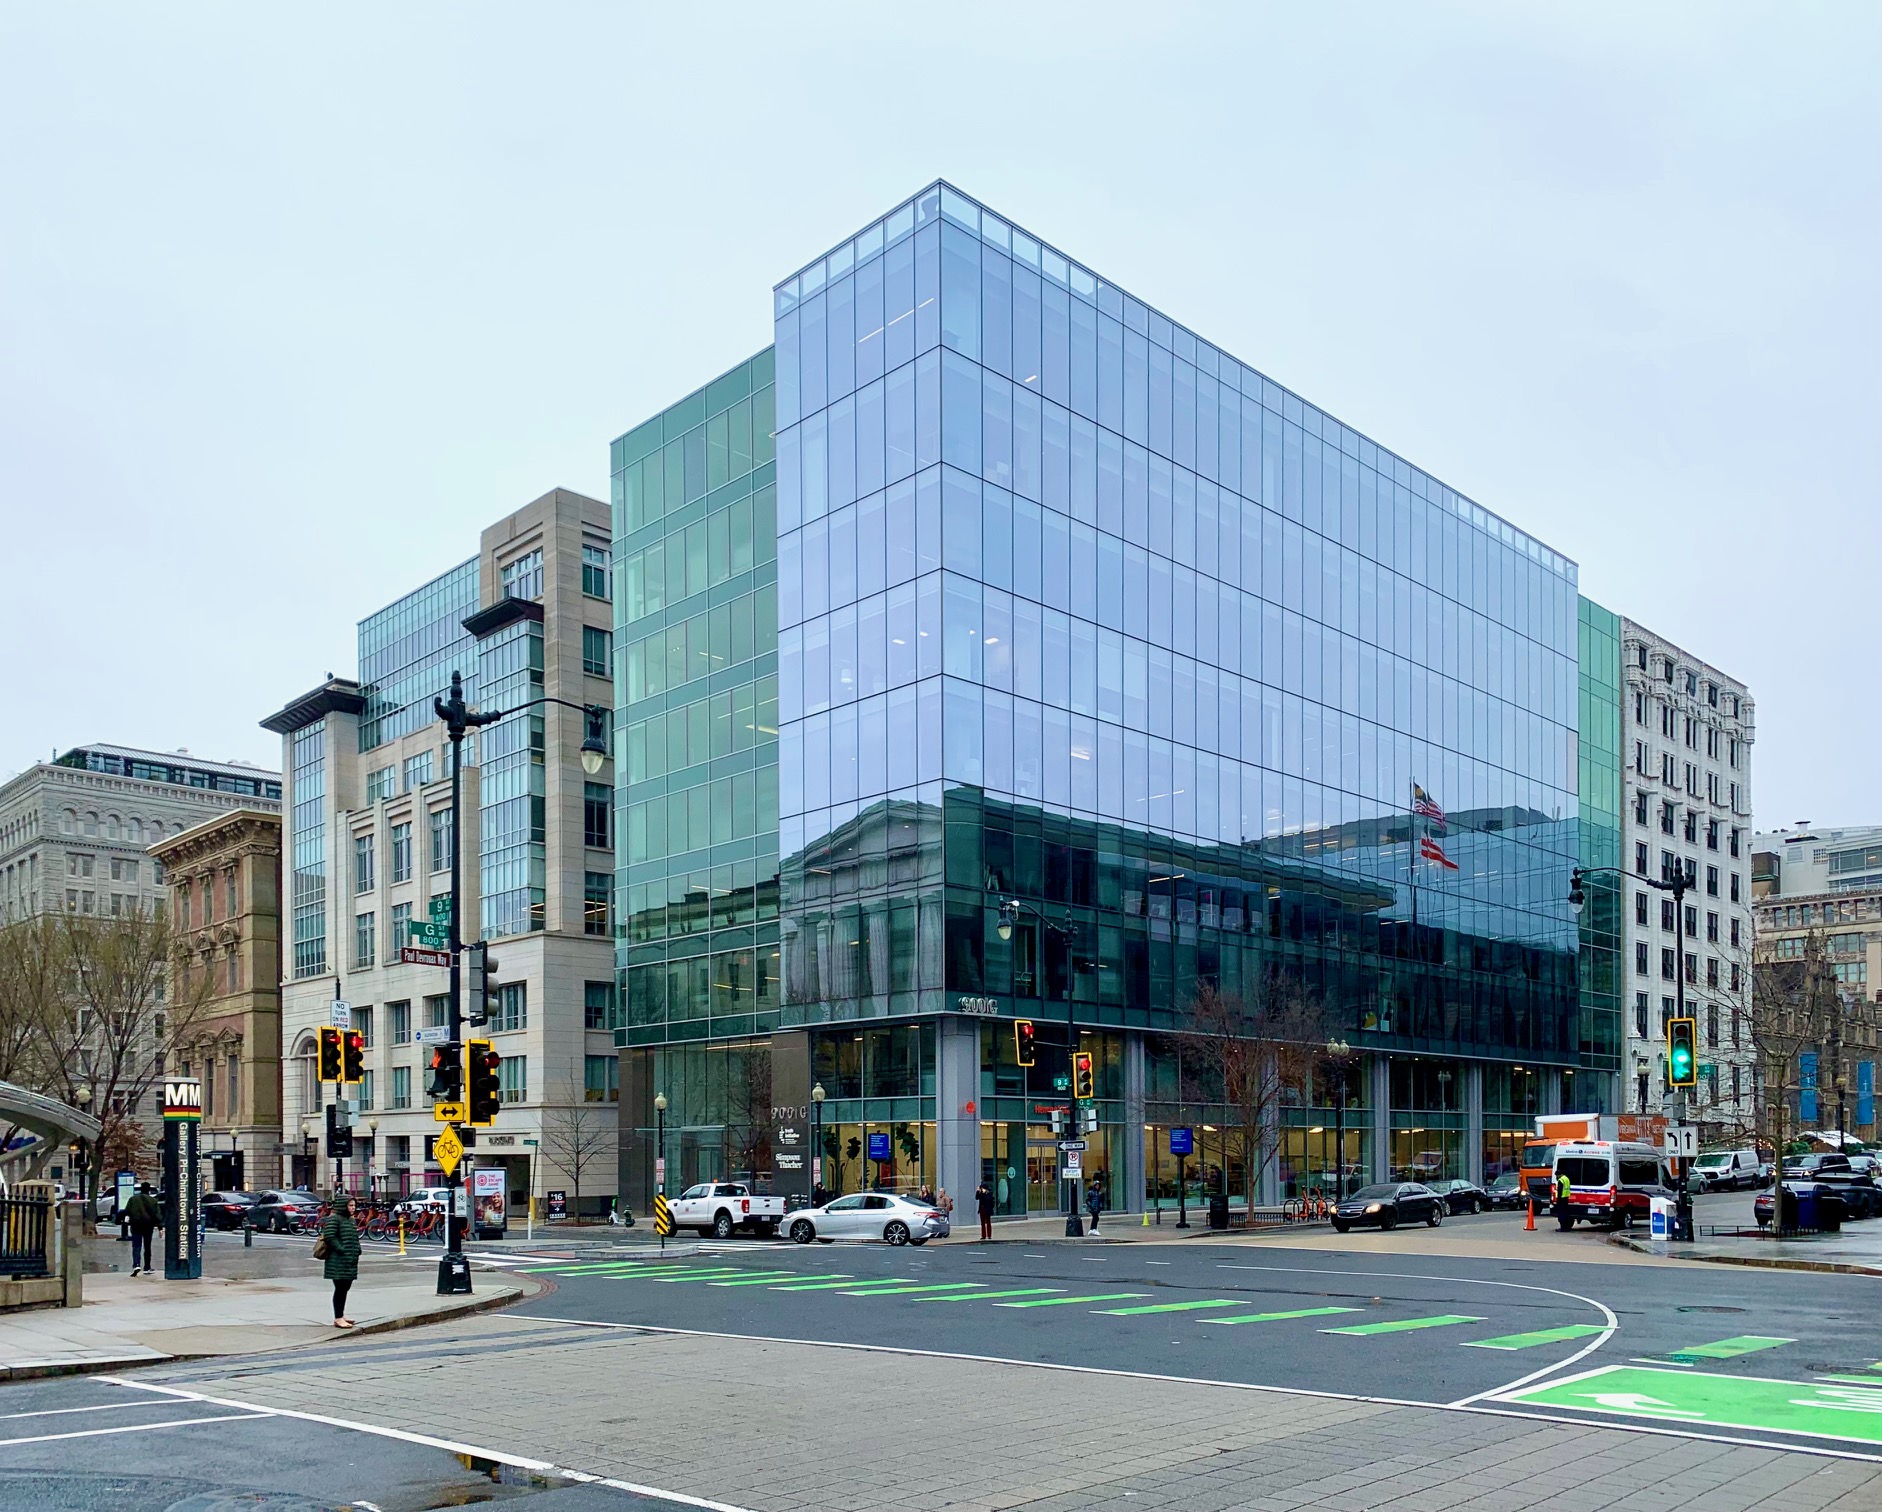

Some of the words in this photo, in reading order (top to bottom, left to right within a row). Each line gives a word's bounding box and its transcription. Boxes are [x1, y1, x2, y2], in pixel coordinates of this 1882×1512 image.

[437, 901, 443, 912] 9
[436, 912, 446, 921] 600
[425, 924, 435, 936] G
[422, 936, 439, 945] 800
[404, 949, 415, 962] Paul
[437, 953, 447, 967] Way
[165, 1083, 188, 1107] M
[189, 1083, 201, 1107] M
[179, 1122, 188, 1156] Gallery
[775, 1152, 801, 1162] Simpson
[179, 1158, 188, 1222] Pl-Chinatown
[551, 1193, 563, 1201] $16
[179, 1224, 188, 1259] Station
